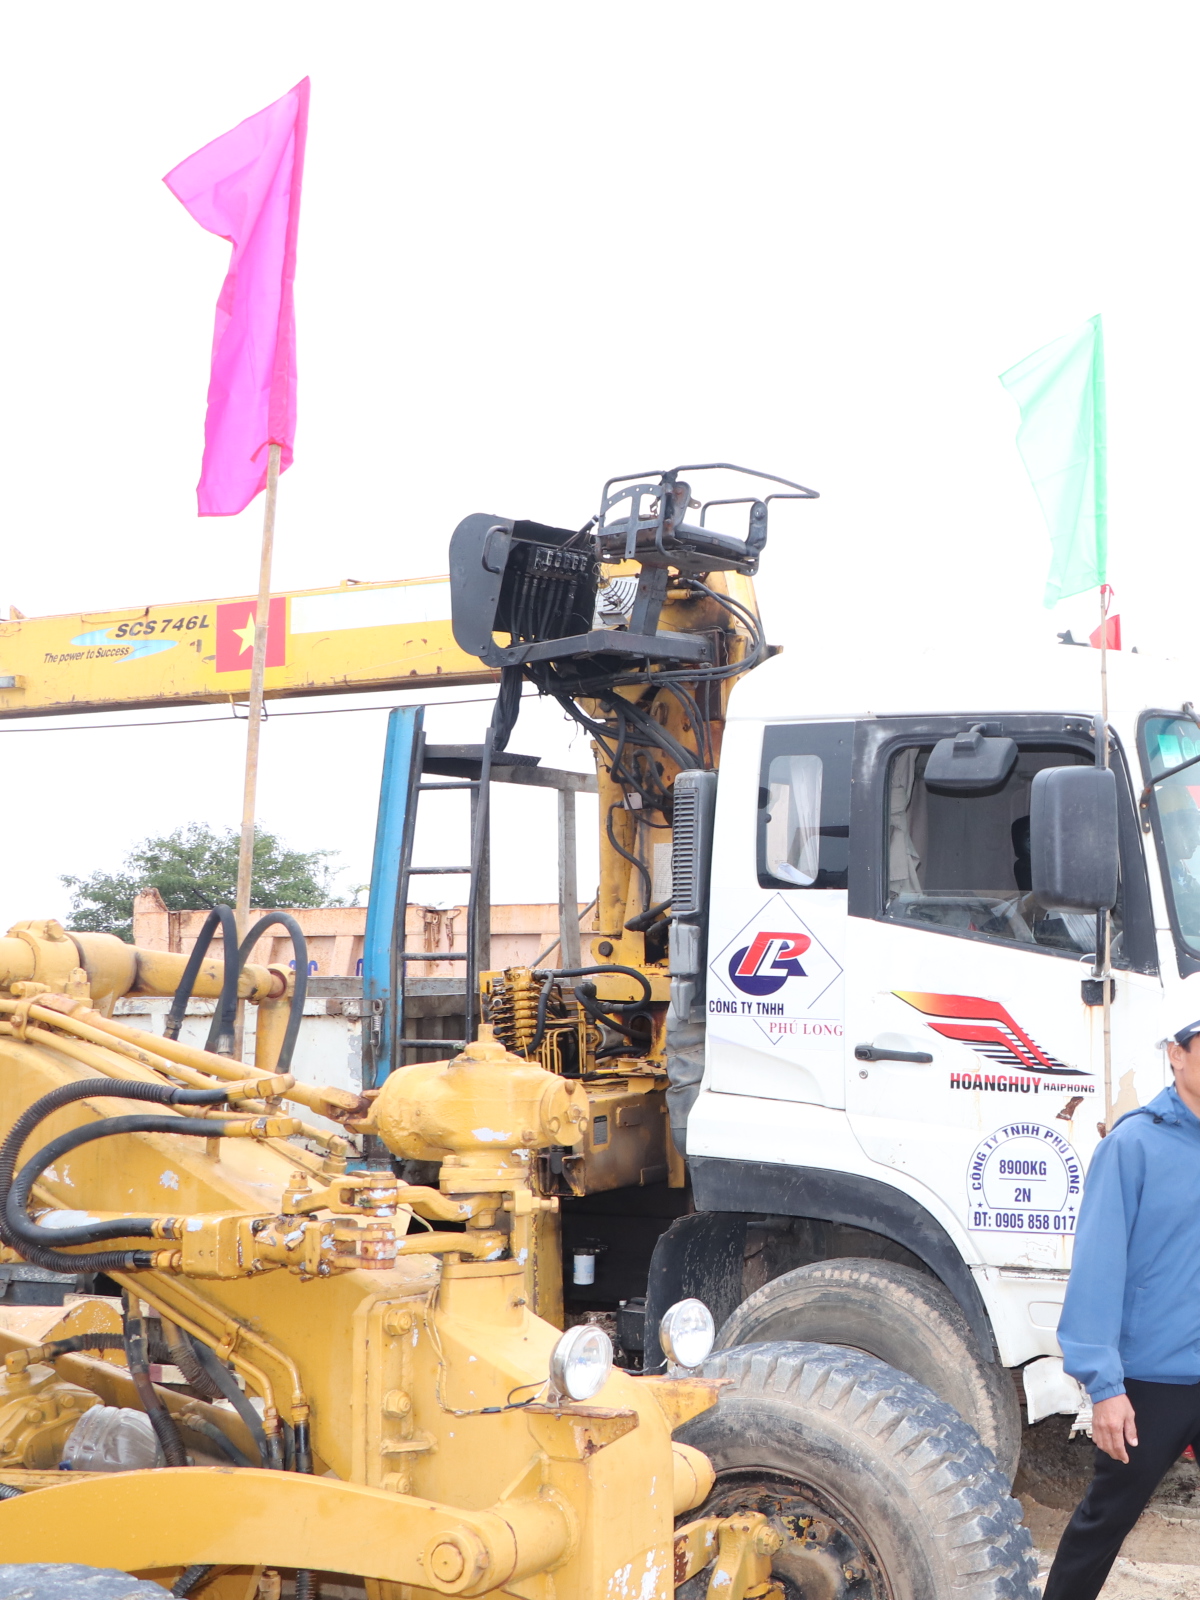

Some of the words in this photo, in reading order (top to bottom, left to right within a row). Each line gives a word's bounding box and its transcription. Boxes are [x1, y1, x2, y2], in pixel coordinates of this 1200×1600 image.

[44, 653, 58, 664] The
[58, 651, 84, 665] power
[86, 649, 95, 660] to
[95, 646, 131, 659] Success
[708, 998, 738, 1015] CÔNG
[741, 1001, 753, 1015] TY
[756, 1002, 785, 1016] TNHH
[769, 1020, 798, 1035] PHÚ
[803, 1023, 843, 1037] LONG
[950, 1073, 1042, 1094] HOANGHUY
[1043, 1082, 1095, 1094] HAIPHONG
[970, 1151, 987, 1191] CÔNG
[983, 1135, 999, 1150] TY
[1002, 1124, 1040, 1139] TNHH
[1043, 1130, 1071, 1154] PHÚ
[1064, 1156, 1080, 1195] LONG
[999, 1159, 1047, 1176] 8900KG
[1014, 1188, 1031, 1203] 2N
[974, 1211, 992, 1228] ĐT:
[995, 1212, 1024, 1229] 0905
[1028, 1214, 1050, 1230] 858
[1053, 1215, 1076, 1231] 017
